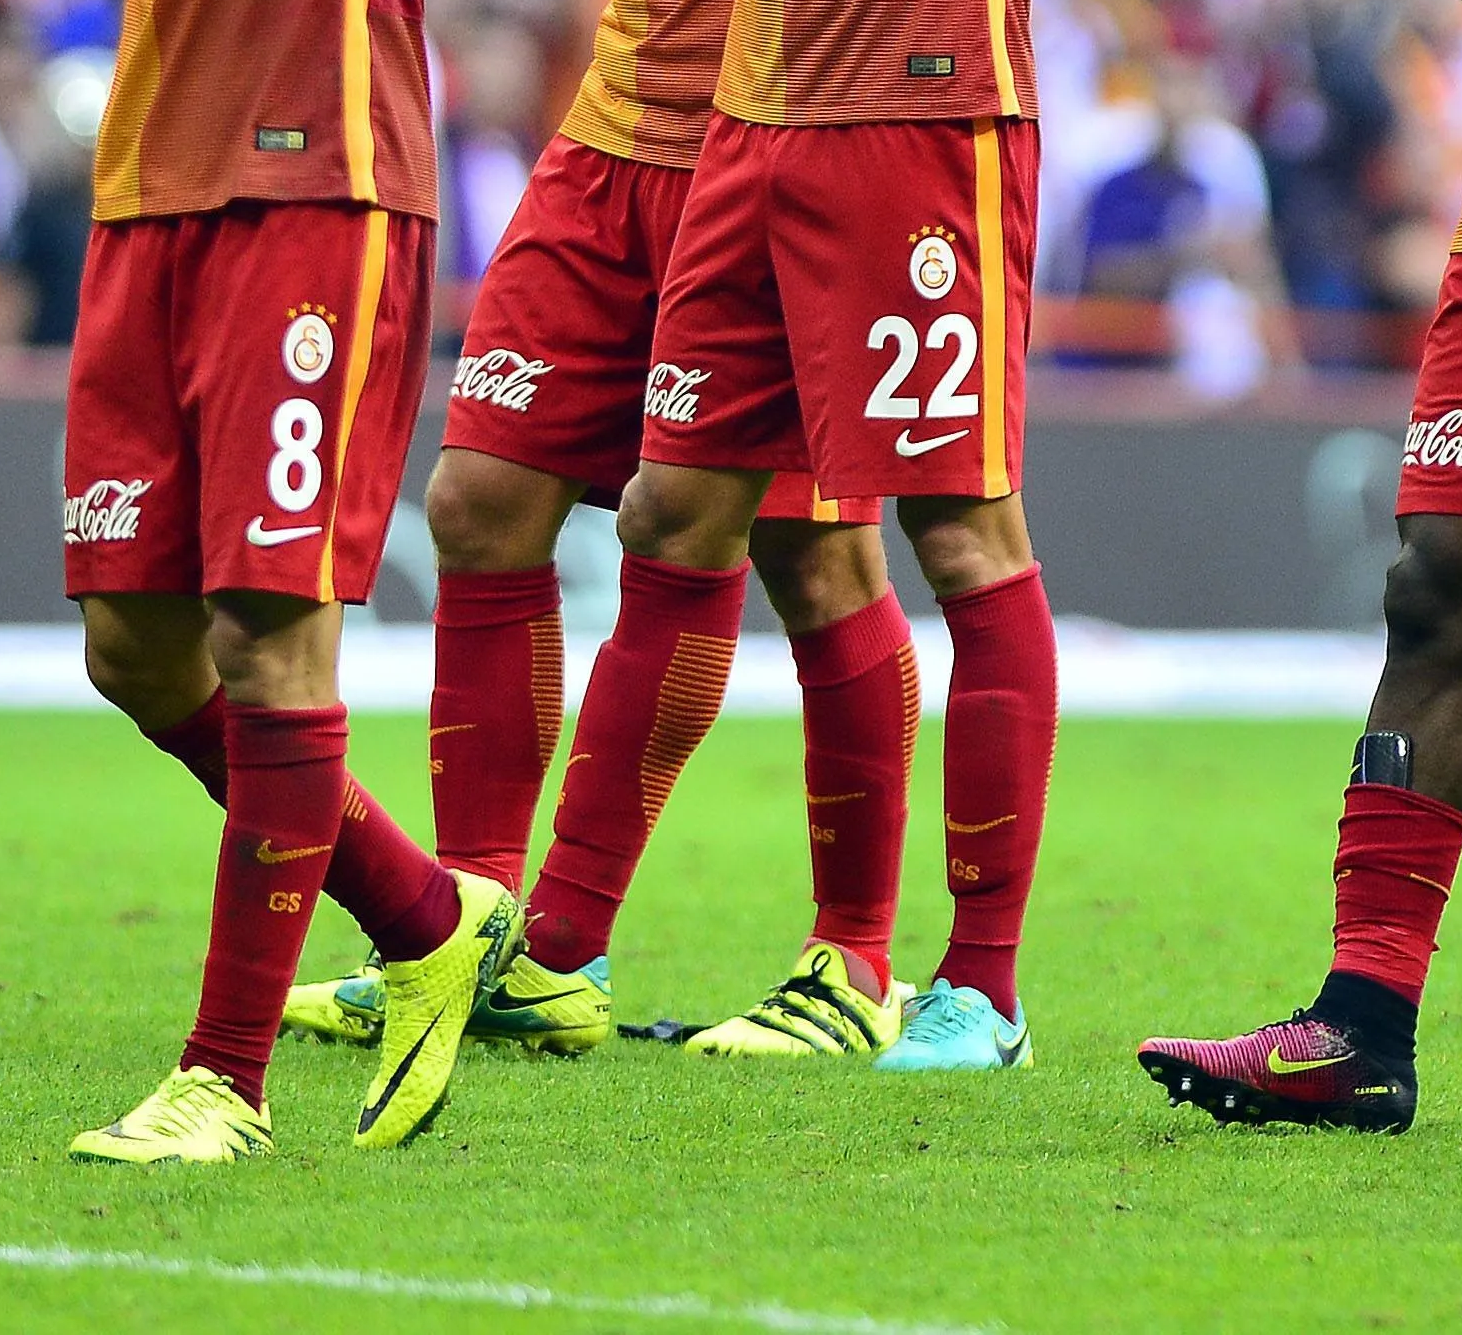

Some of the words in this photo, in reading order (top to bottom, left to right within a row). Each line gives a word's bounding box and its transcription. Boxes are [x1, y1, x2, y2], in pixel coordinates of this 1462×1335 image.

[864, 313, 979, 420] 22
[267, 398, 323, 512] 8
[951, 857, 981, 881] GS
[269, 891, 303, 913] GS
